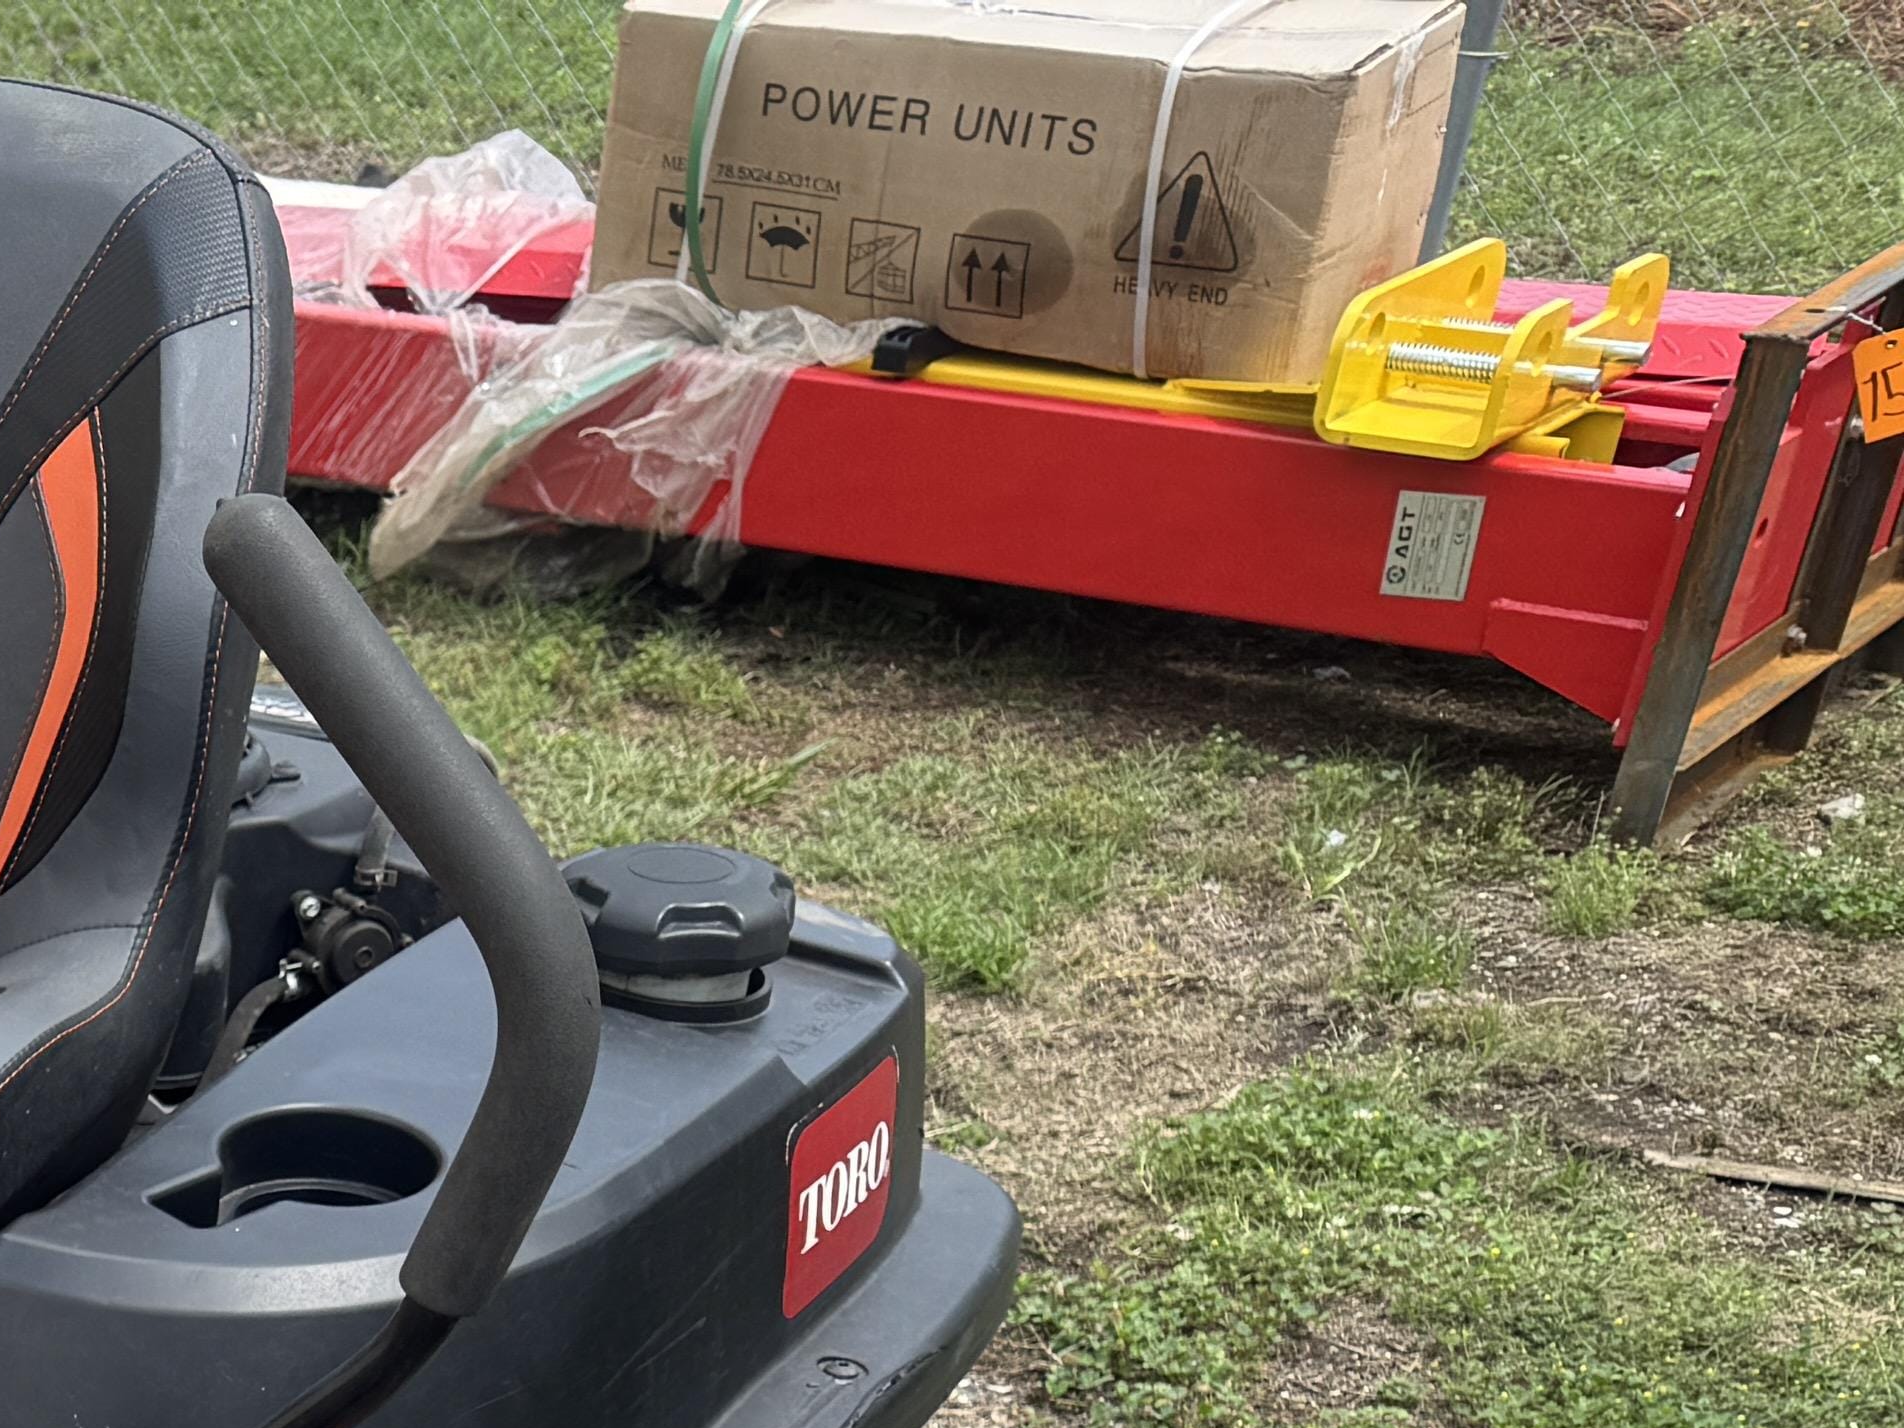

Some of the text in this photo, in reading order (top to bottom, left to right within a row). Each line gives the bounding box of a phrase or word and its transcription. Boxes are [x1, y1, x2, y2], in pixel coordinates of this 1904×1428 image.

[761, 82, 1098, 155] POWER UNITS
[1113, 275, 1229, 305] HEVY END
[1394, 506, 1416, 559] AGT
[798, 1121, 890, 1255] TORO
